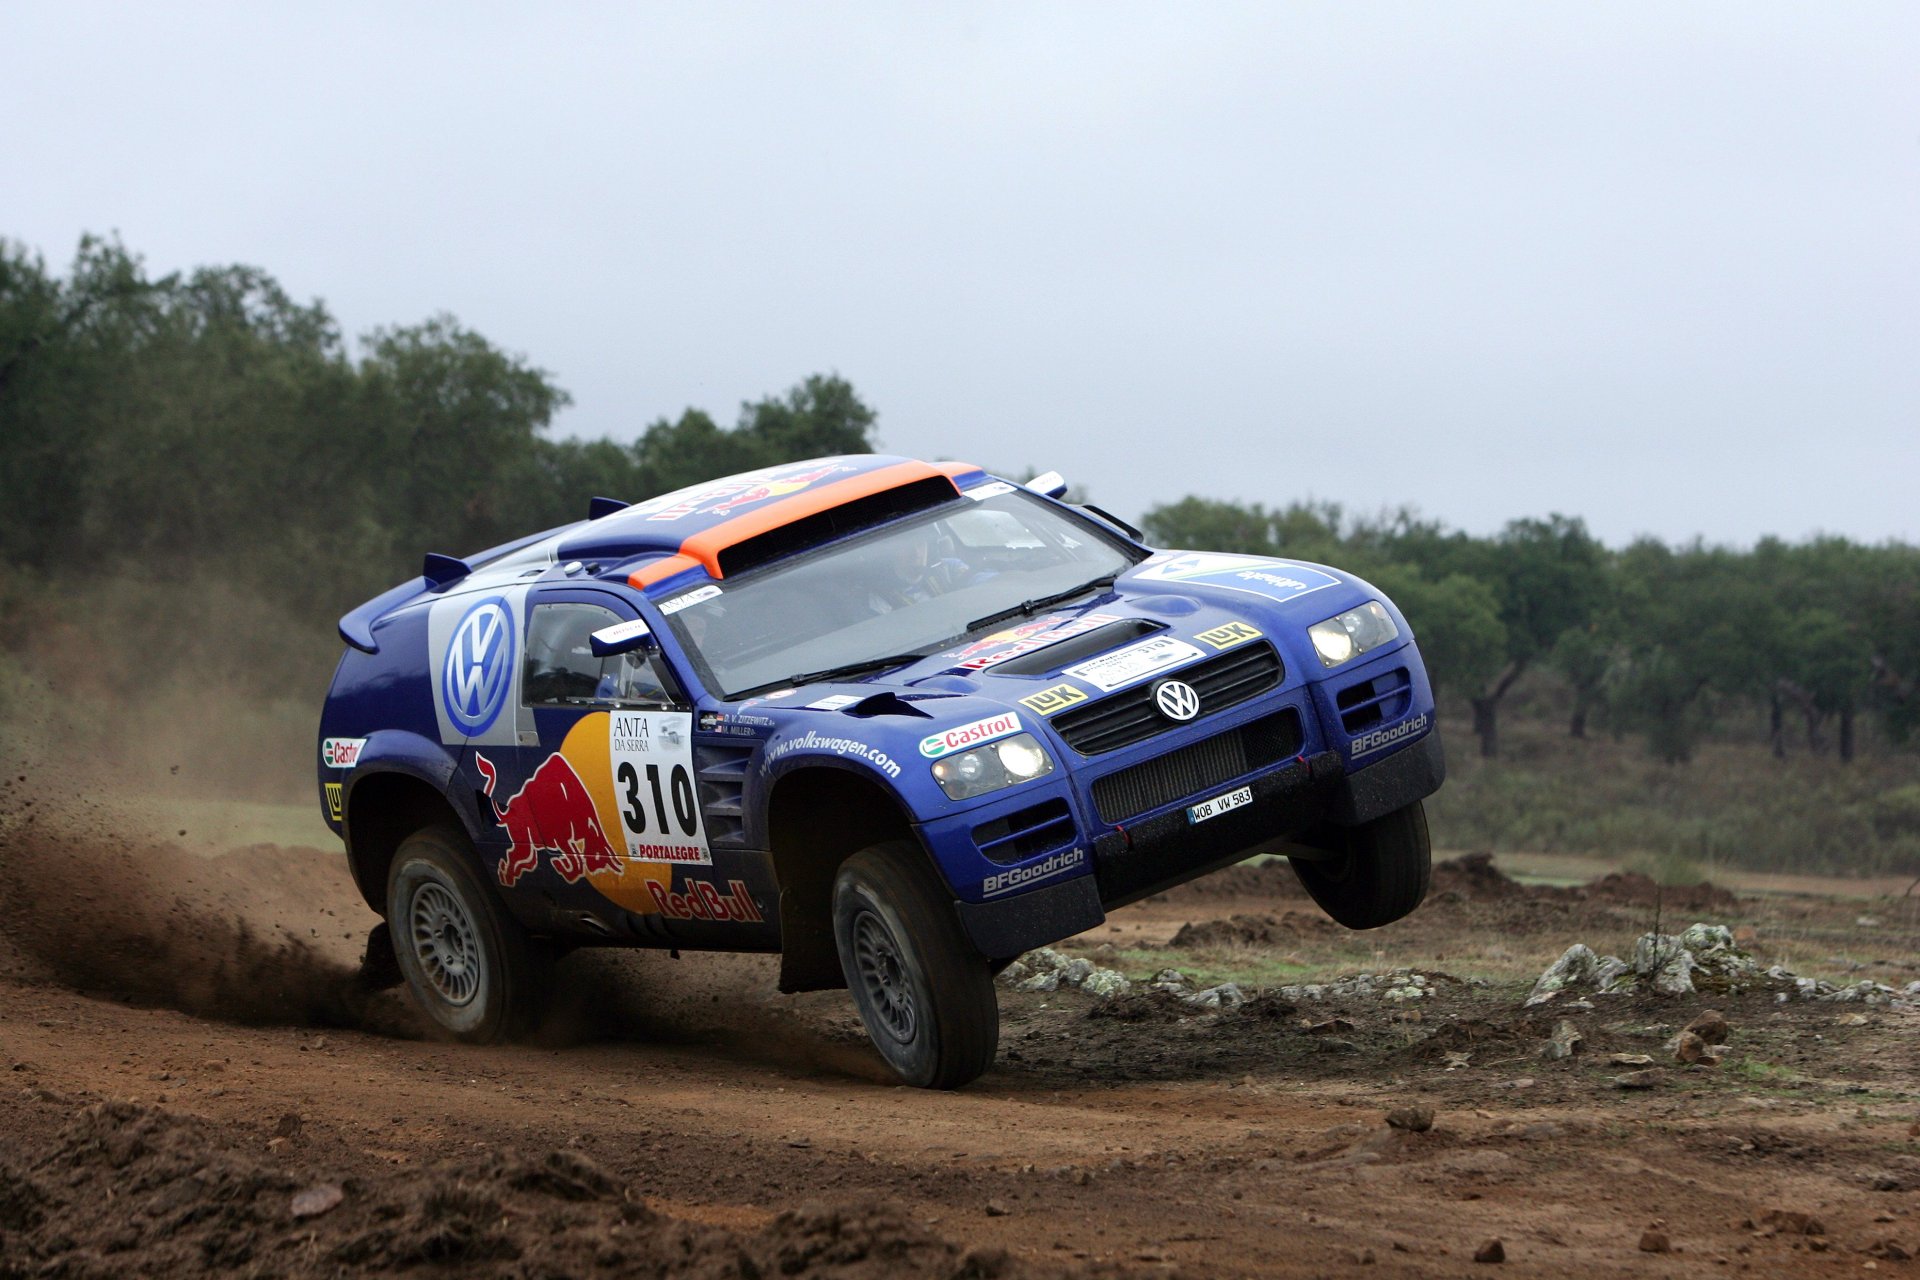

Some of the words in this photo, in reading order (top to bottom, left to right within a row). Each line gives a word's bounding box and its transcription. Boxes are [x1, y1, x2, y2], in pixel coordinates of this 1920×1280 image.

[614, 717, 649, 738] ANTA
[614, 739, 626, 752] DA
[627, 739, 649, 752] SERRA
[945, 716, 1015, 748] Castrol
[1351, 712, 1428, 756] BFGoodrich
[759, 730, 901, 778] www.volkswagen.com
[617, 761, 697, 837] 310
[1193, 804, 1213, 820] WOB
[1217, 797, 1231, 811] VW
[1232, 790, 1251, 806] 583
[639, 844, 700, 861] PORTALEGRE
[983, 847, 1084, 895] BFGoodrich
[644, 878, 713, 920] Red
[695, 880, 764, 923] Bull
